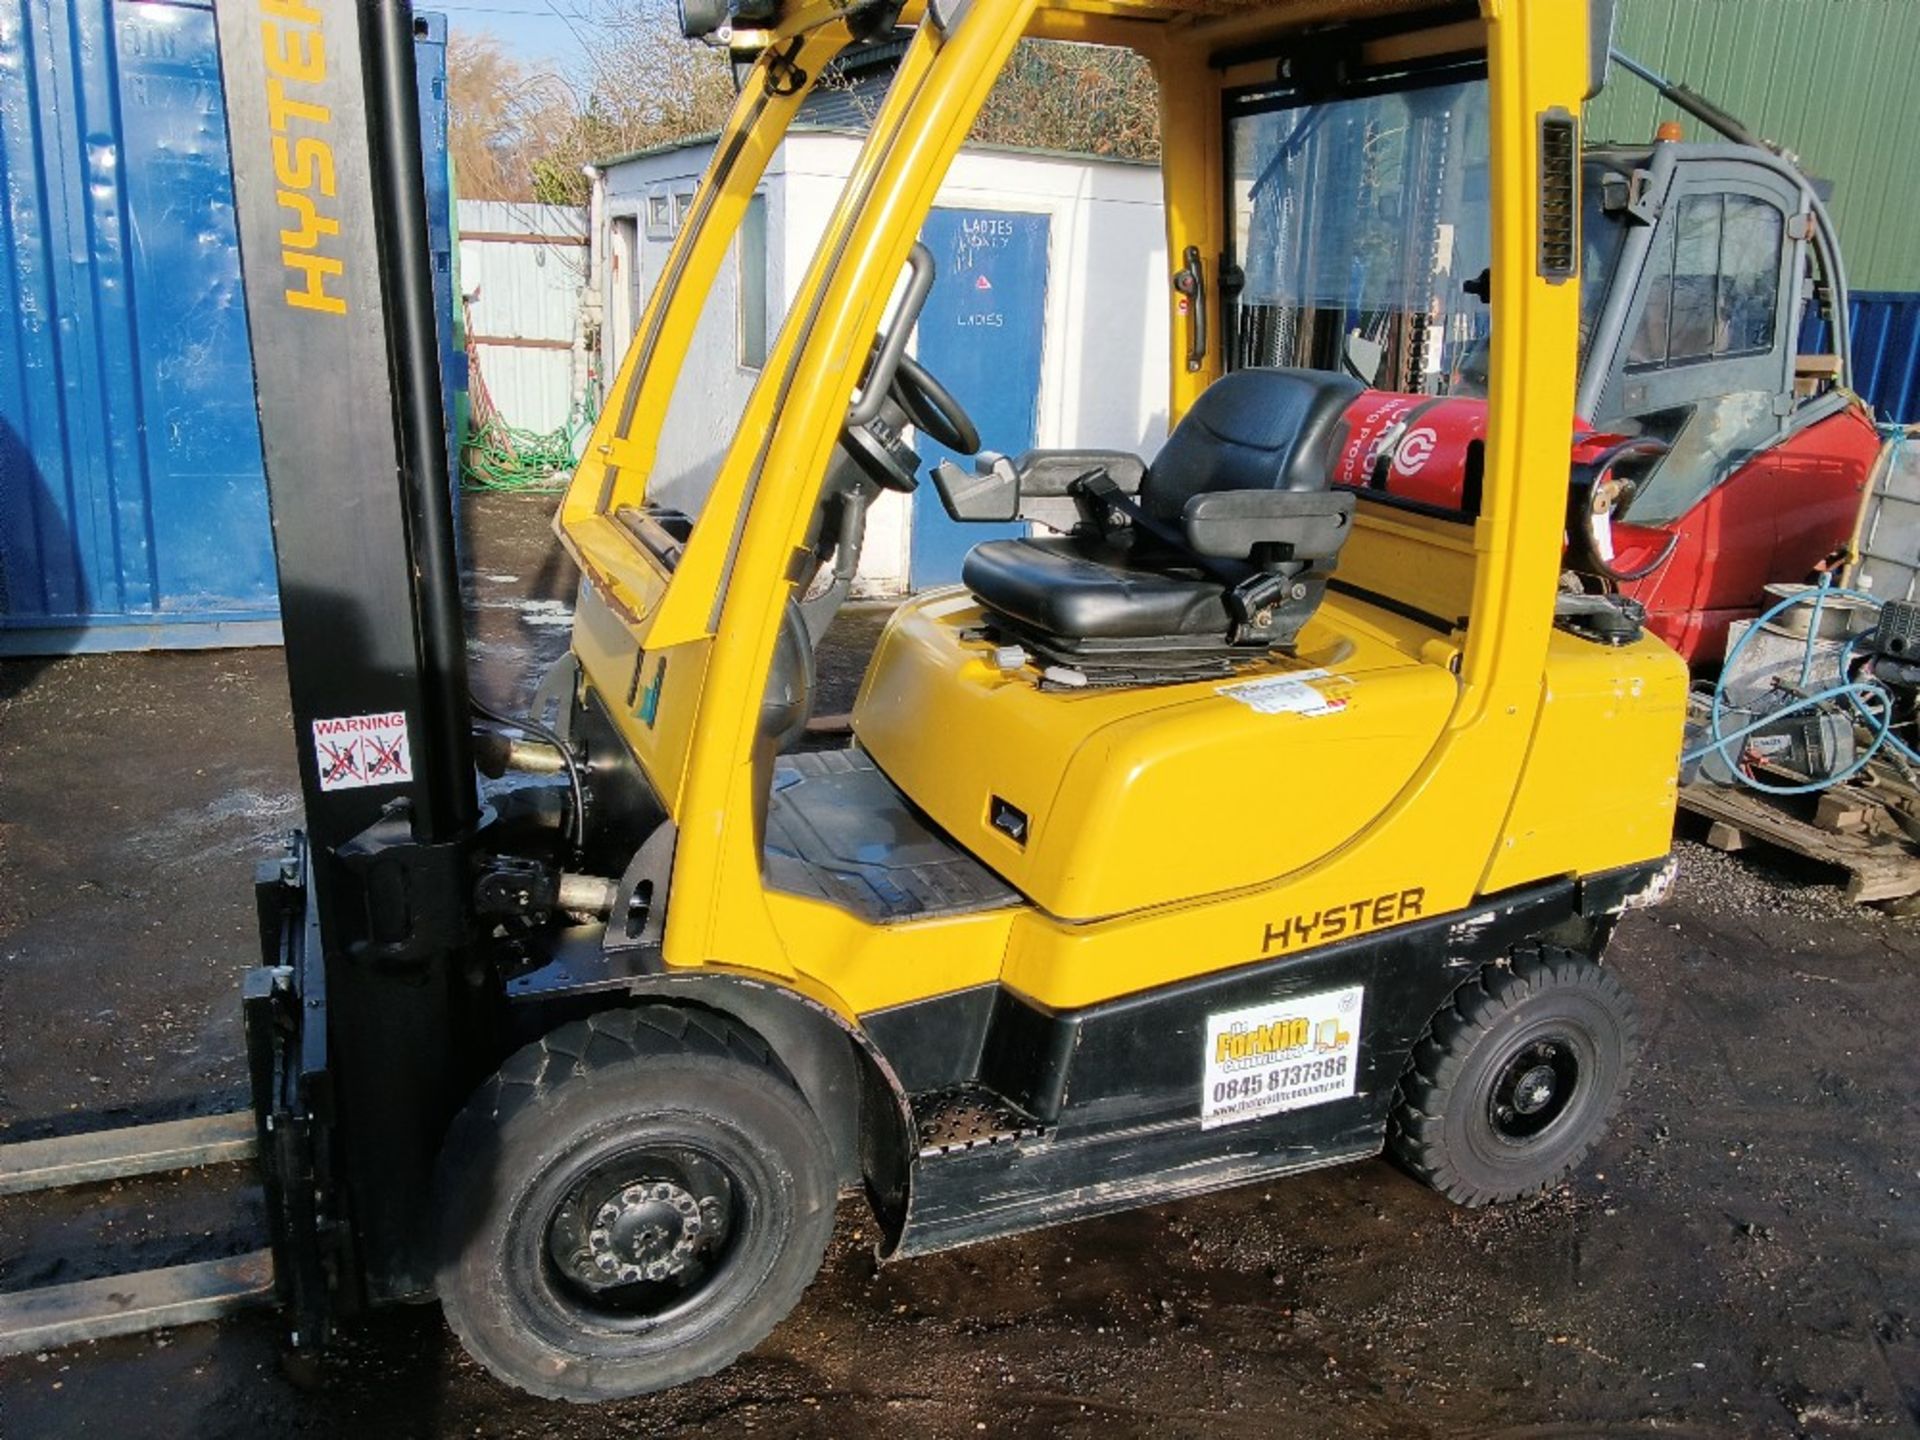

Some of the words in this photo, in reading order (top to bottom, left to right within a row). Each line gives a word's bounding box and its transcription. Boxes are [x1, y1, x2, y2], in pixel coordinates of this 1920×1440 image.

[962, 218, 1013, 236] LADIES
[316, 714, 404, 736] WARNING
[1261, 886, 1426, 953] HYSTER
[1215, 1017, 1310, 1064] Forklift
[1213, 1073, 1263, 1103] 0845
[1268, 1055, 1348, 1092] 8737388
